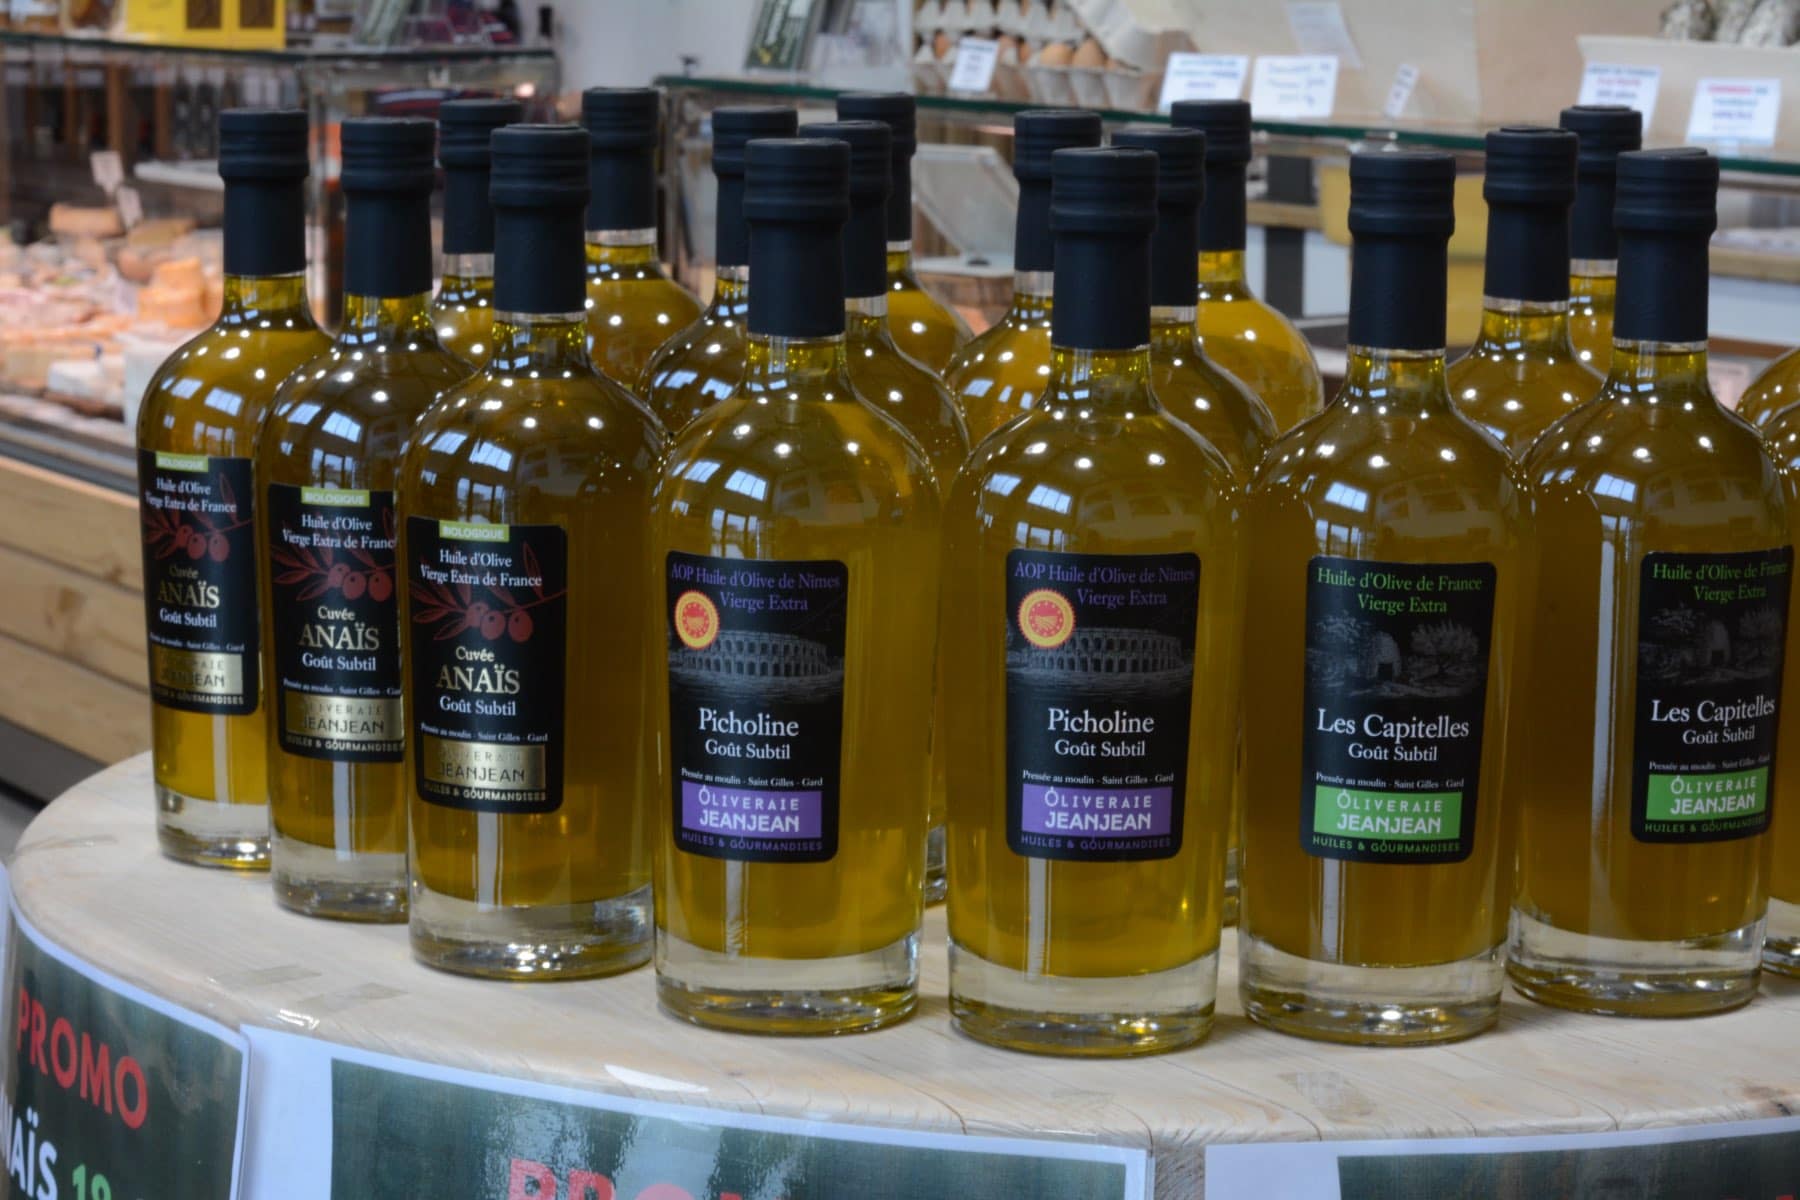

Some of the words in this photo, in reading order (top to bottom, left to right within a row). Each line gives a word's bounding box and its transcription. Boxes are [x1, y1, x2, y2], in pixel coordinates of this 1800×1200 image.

[187, 497, 200, 512] de
[201, 499, 237, 512] France
[302, 514, 329, 529] Huile
[331, 517, 372, 531] d'Olive
[442, 526, 504, 539] BIOLOGIQUE
[282, 528, 310, 548] Vierge
[312, 532, 341, 548] Extra
[343, 536, 357, 548] de
[361, 535, 396, 549] Franc
[440, 549, 467, 565] Huile
[470, 552, 512, 567] d'Olive
[420, 564, 448, 584] Vierge
[451, 569, 479, 585] Extra
[483, 572, 496, 586] de
[500, 572, 542, 586] France
[672, 564, 693, 581] AOP
[697, 568, 726, 585] Huile
[730, 569, 774, 587] d'Olive
[778, 573, 794, 589] de
[1015, 562, 1047, 579] AOP
[1049, 564, 1084, 583] Huile
[1088, 566, 1136, 584] d'Olive
[1140, 568, 1155, 583] de
[1318, 568, 1356, 587] Huile
[1360, 572, 1412, 591] d'Olive
[1416, 575, 1434, 591] de
[1438, 576, 1482, 591] France
[1653, 563, 1692, 580] Huile
[1696, 564, 1742, 580] d'Olive
[1744, 564, 1757, 578] de
[157, 579, 220, 608] ANAÏS
[720, 592, 764, 613] Vierge
[769, 594, 808, 611] Extra
[1077, 588, 1125, 609] Vierge
[1129, 589, 1168, 606] Extra
[1693, 585, 1735, 605] Vierge
[1738, 585, 1767, 599] Extra
[318, 606, 356, 621] Cuvée
[1358, 593, 1405, 616] Vierge
[1409, 596, 1447, 613] Extra
[160, 607, 182, 625] Goût
[184, 612, 216, 628] Subtil
[297, 622, 380, 651] ANAÏS
[302, 652, 333, 670] Goût
[337, 656, 376, 672] Subtil
[456, 646, 495, 662] Cuvée
[436, 664, 520, 694] ANAÏS
[440, 696, 471, 714] Goût
[475, 700, 516, 716] Subtil
[1650, 700, 1690, 722] Les
[1697, 694, 1776, 726] Capitelles
[698, 707, 799, 737] Picholine
[1048, 707, 1155, 734] Picholine
[1317, 707, 1356, 735] Les
[1363, 713, 1470, 744] Capitelles
[1683, 729, 1718, 745] Goût
[1722, 725, 1755, 743] Subtil
[705, 738, 742, 758] Goût
[746, 743, 790, 760] Subtil
[1055, 739, 1096, 756] Goût
[1101, 740, 1146, 757] Subtil
[1348, 742, 1388, 761] Goût
[1393, 746, 1438, 761] Subtil
[714, 774, 741, 784] moulin
[748, 777, 768, 786] Saint
[770, 777, 794, 787] Gilles
[802, 777, 823, 786] Gard
[1065, 774, 1094, 785] moulin
[1102, 776, 1123, 785] Saint
[1357, 777, 1386, 788] moulin
[1394, 779, 1415, 788] Saint
[1417, 779, 1439, 789] Gilles
[1670, 793, 1755, 815] JEANJEAN
[700, 810, 799, 832] JEANJEAN
[1045, 812, 1151, 831] JEANJEAN
[1337, 814, 1441, 834] JEANJEAN
[1645, 823, 1685, 832] HUILES
[682, 830, 714, 845] HUILES
[1021, 836, 1062, 848] HUILES
[1313, 836, 1352, 849] HUILES
[17, 986, 148, 1129] PROMO
